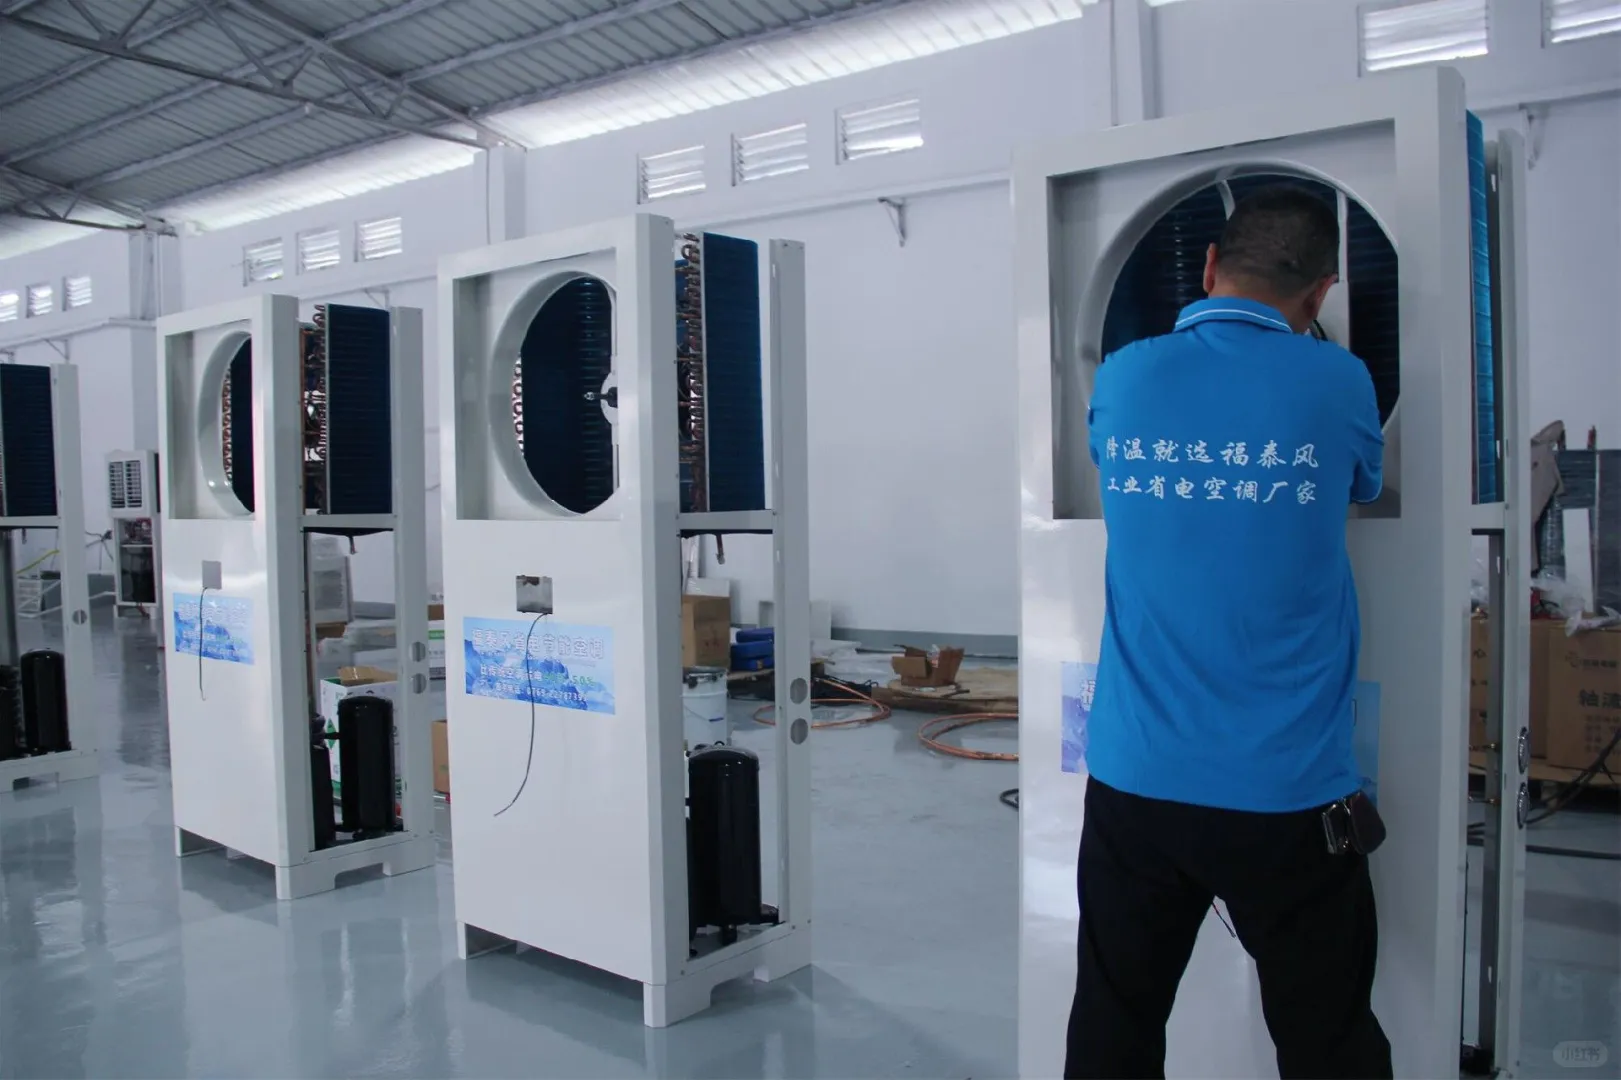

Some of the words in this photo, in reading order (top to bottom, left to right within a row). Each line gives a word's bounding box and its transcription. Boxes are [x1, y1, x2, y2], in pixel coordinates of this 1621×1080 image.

[1107, 476, 1317, 505] 工业省电空调厂家
